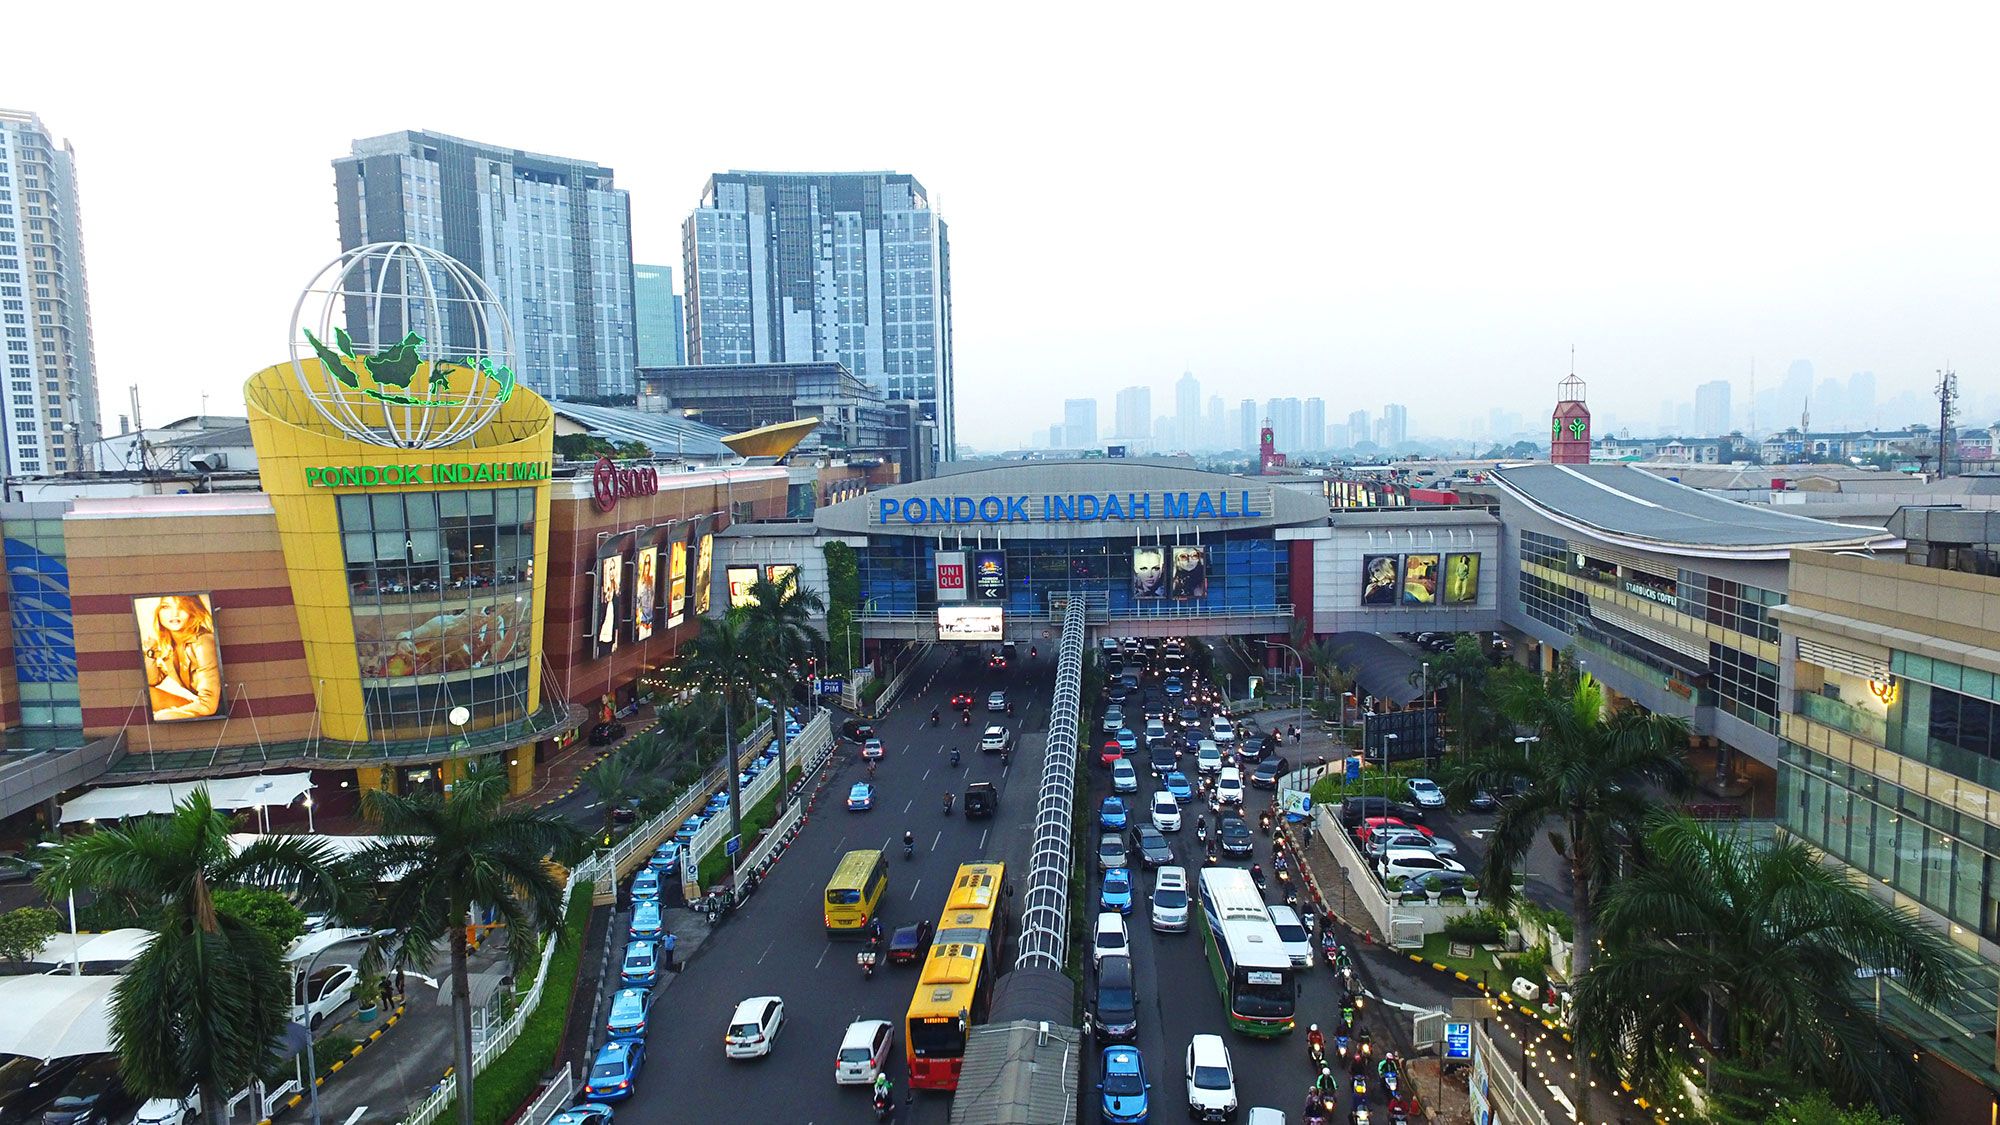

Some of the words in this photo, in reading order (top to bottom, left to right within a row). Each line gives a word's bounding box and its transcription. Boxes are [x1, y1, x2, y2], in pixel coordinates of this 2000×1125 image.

[305, 464, 424, 488] PONDOK
[431, 462, 508, 484] INDAH
[512, 461, 553, 481] MALL
[619, 467, 659, 499] SOGO
[879, 495, 1031, 525] PONDOK
[1043, 491, 1150, 522] INDAH
[1163, 490, 1262, 520] MALL
[940, 566, 959, 576] UNI
[941, 577, 961, 587] QLO
[1625, 582, 1657, 600] STARBUCKS
[824, 685, 839, 693] PIM
[1460, 1025, 1467, 1034] P
